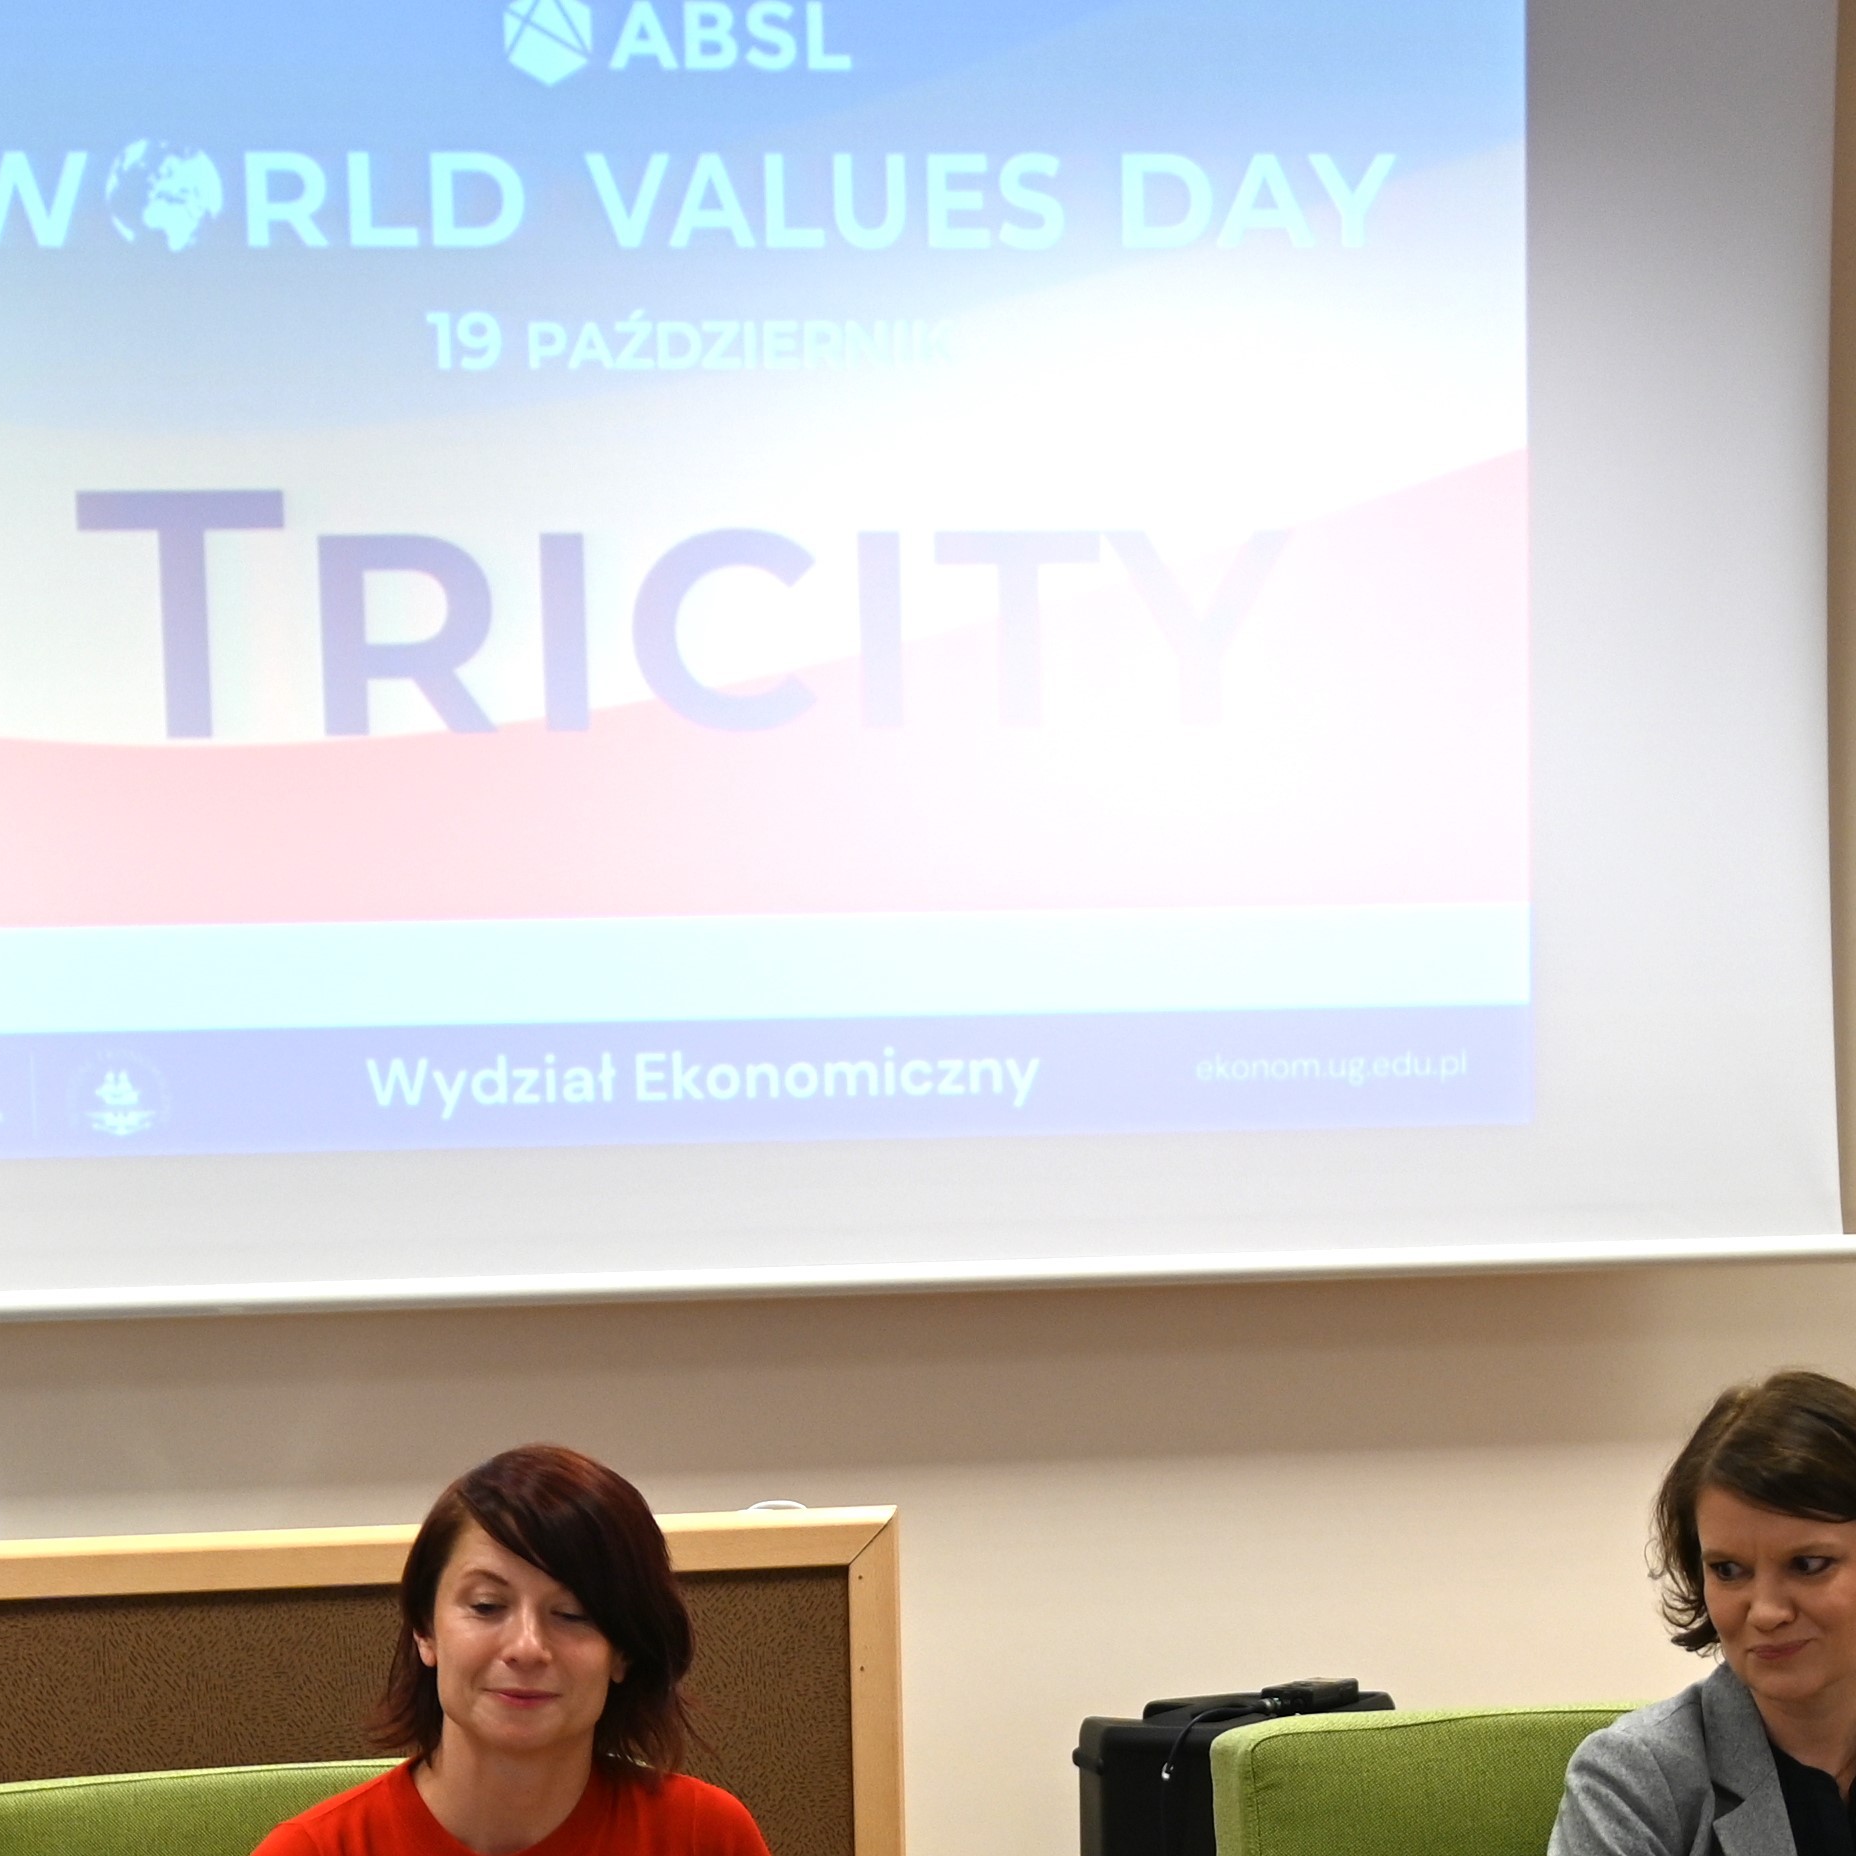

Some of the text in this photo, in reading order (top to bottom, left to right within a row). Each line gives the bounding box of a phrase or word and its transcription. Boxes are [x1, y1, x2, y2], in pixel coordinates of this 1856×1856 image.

[609, 0, 852, 71] ABSL
[585, 151, 1066, 251] VALUES
[1121, 152, 1398, 250] DAY
[426, 311, 502, 371] 19
[365, 1047, 1040, 1120] Wydział Ekonomiczny
[1195, 1049, 1467, 1088] ekonom.ug.edu.pl
